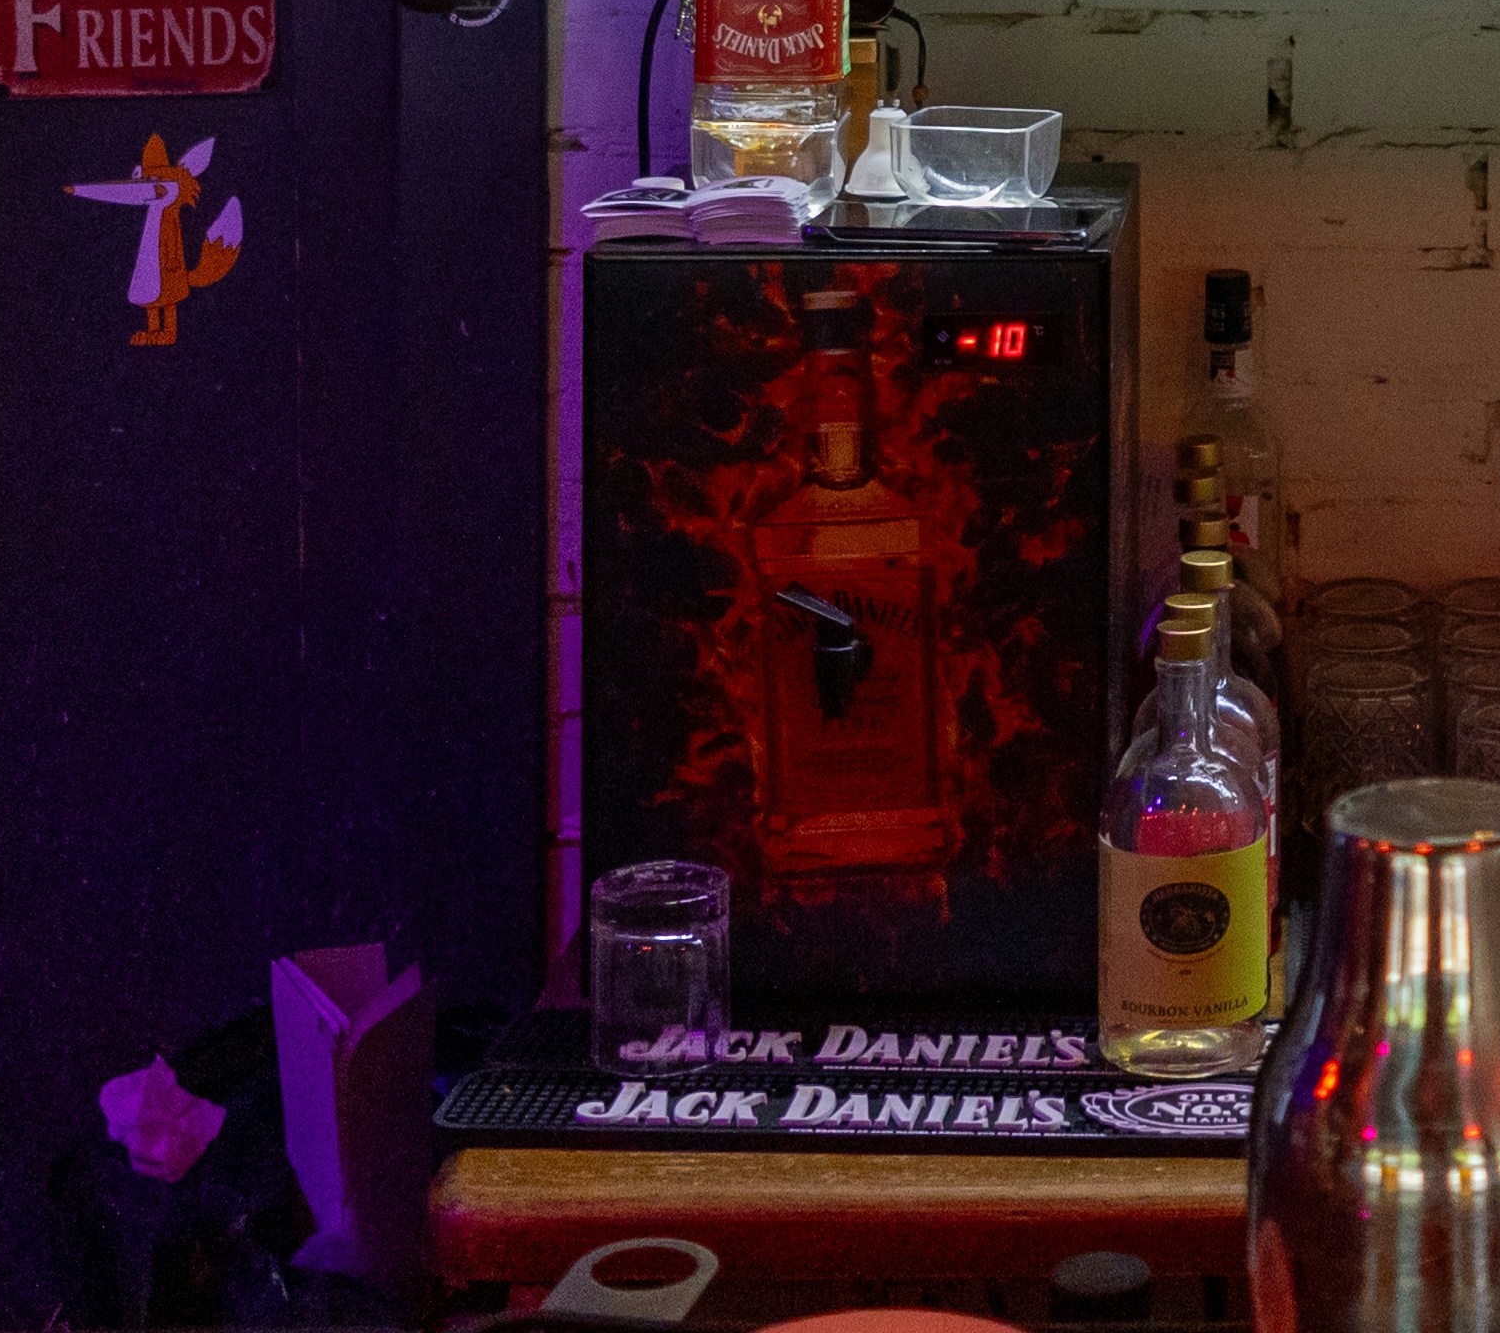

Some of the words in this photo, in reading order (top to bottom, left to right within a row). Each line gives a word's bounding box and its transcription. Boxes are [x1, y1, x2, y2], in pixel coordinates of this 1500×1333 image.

[1119, 999, 1189, 1018] BOURBON
[1192, 995, 1250, 1016] VANILLA
[576, 1082, 769, 1127] JACK
[779, 1085, 1070, 1131] DANIEL'S
